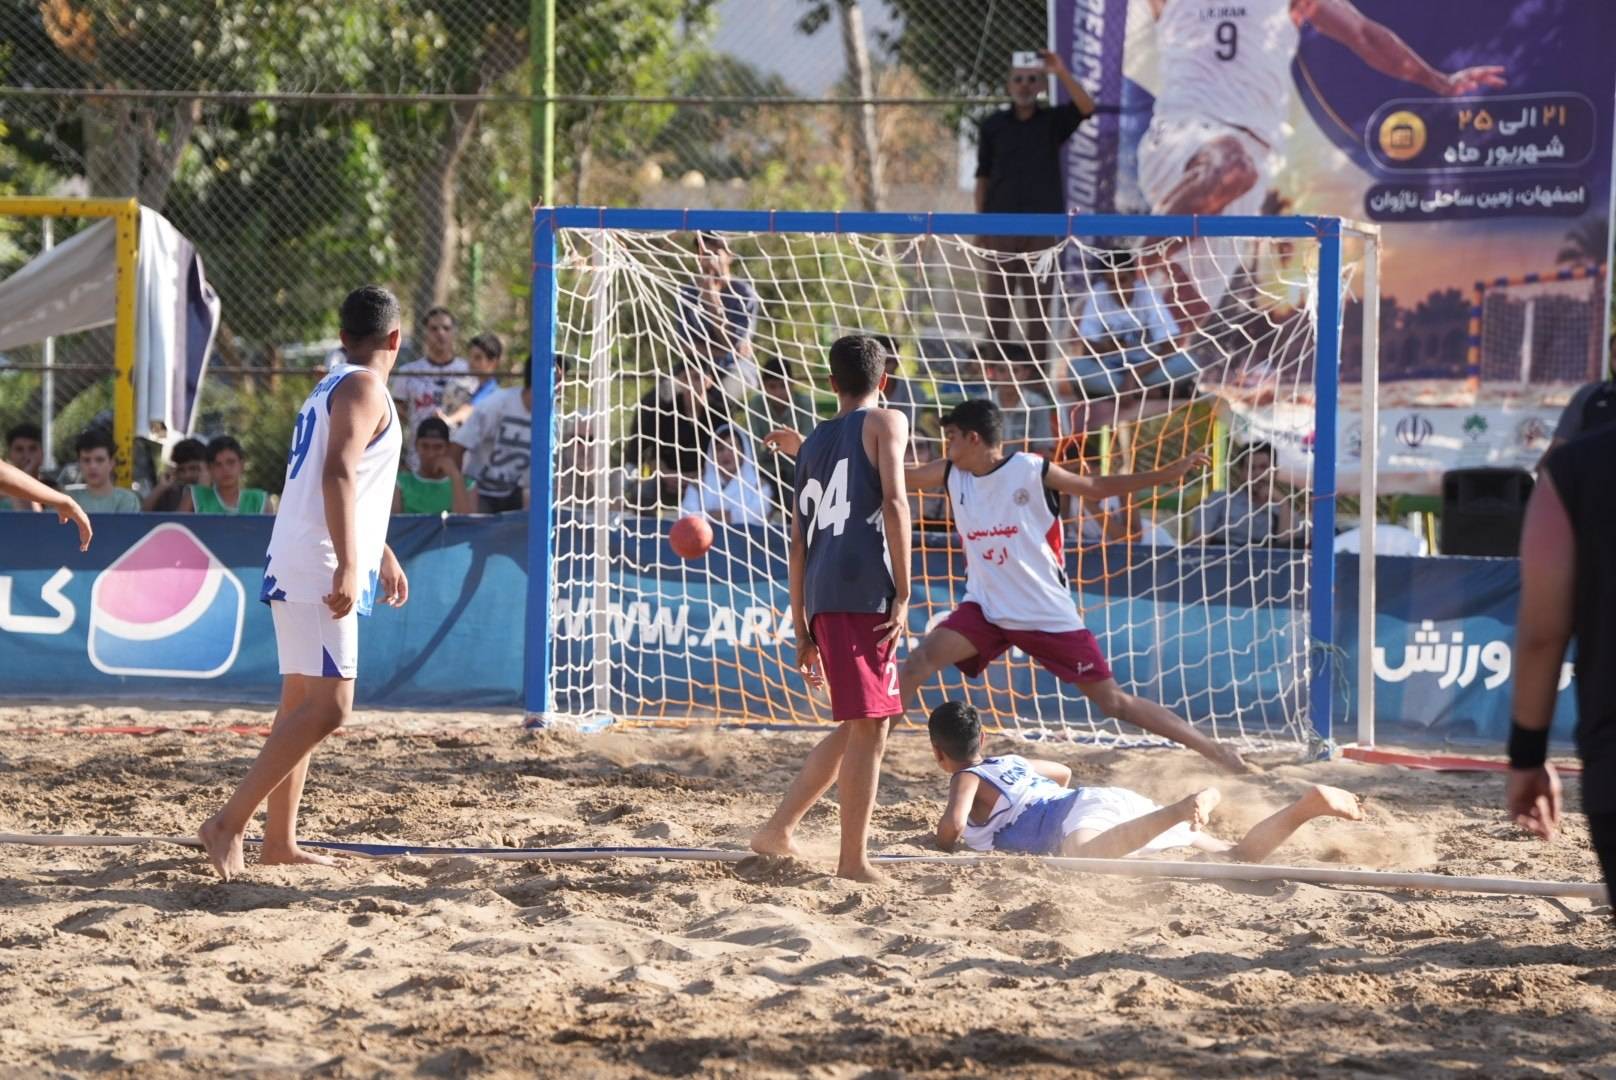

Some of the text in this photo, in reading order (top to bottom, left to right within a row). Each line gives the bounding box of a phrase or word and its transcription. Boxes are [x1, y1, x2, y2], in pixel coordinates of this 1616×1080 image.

[1214, 21, 1238, 62] 9
[1498, 106, 1538, 135] الی
[1444, 134, 1565, 167] شهریور ماه
[967, 523, 1019, 541] مهندسین
[1372, 619, 1512, 691] ورزش
